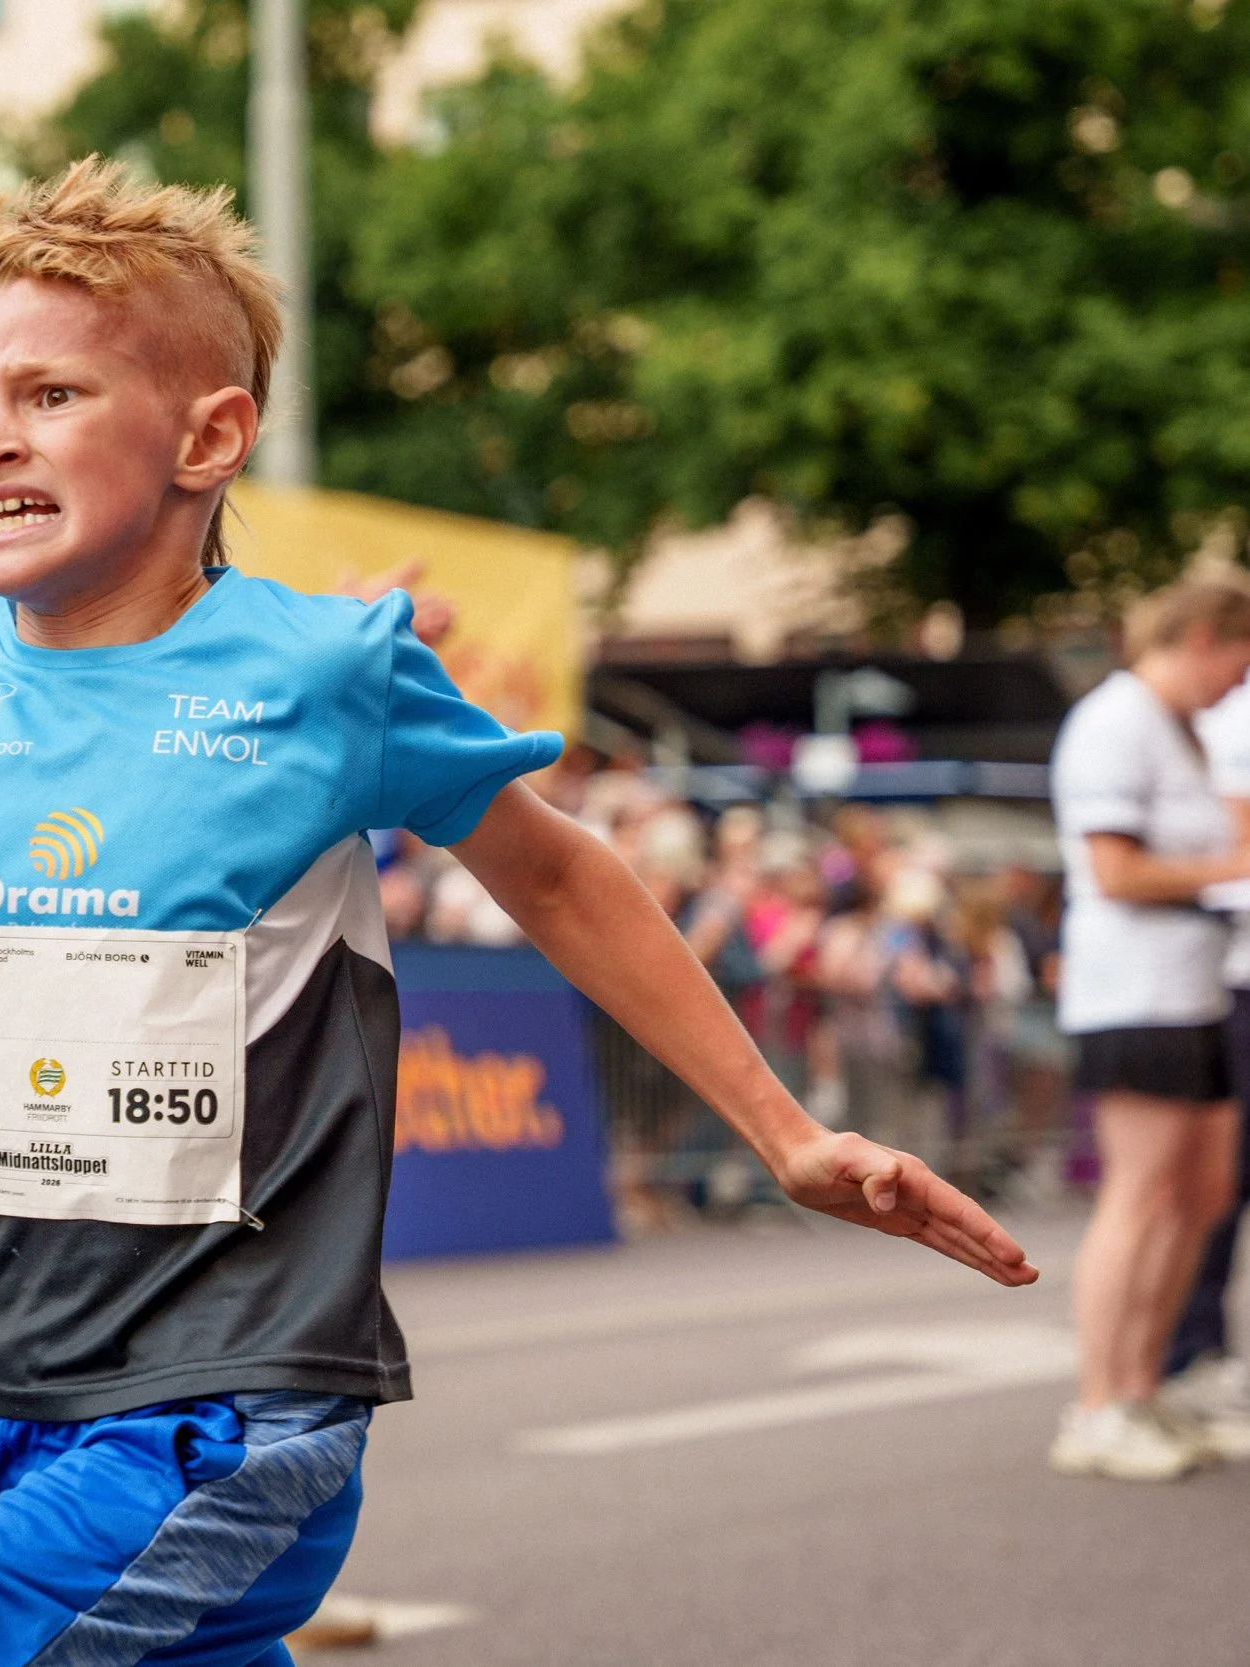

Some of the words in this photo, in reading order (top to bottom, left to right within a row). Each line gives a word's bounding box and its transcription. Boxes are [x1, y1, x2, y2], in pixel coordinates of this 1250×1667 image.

[167, 693, 264, 723] TEAM
[152, 729, 268, 766] ENVOL
[65, 951, 101, 961] BJÖRN
[105, 954, 136, 962] BORG
[186, 950, 224, 959] VITAMIN
[186, 959, 208, 967] WELL
[111, 1060, 215, 1077] STARTTID
[23, 1103, 72, 1112] HAMMARBY
[107, 1088, 218, 1125] 18:50
[30, 1142, 72, 1154] LILLA
[41, 1178, 61, 1187] 2026
